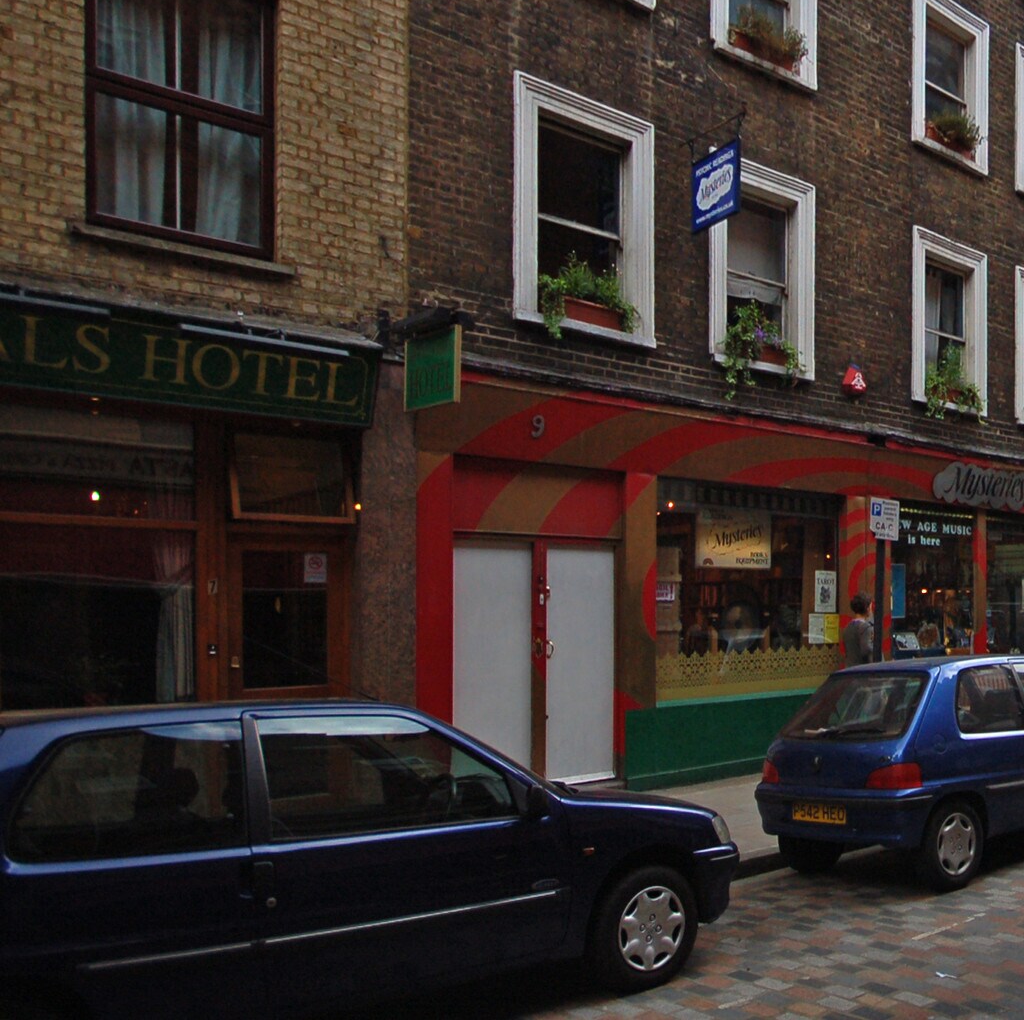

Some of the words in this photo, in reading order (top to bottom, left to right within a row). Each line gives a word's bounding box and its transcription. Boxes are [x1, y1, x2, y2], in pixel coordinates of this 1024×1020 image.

[699, 168, 732, 202] Mysteries
[138, 334, 358, 407] HOTEL
[409, 361, 452, 400] HOTEL
[531, 414, 546, 439] 9
[873, 504, 881, 515] P
[712, 523, 763, 549] Mysteries
[917, 520, 937, 533] AGE
[943, 523, 972, 536] MUSIC
[907, 535, 916, 545] is
[920, 535, 941, 547] here
[209, 580, 216, 593] 7
[816, 577, 835, 585] TAROT
[793, 803, 820, 819] P542
